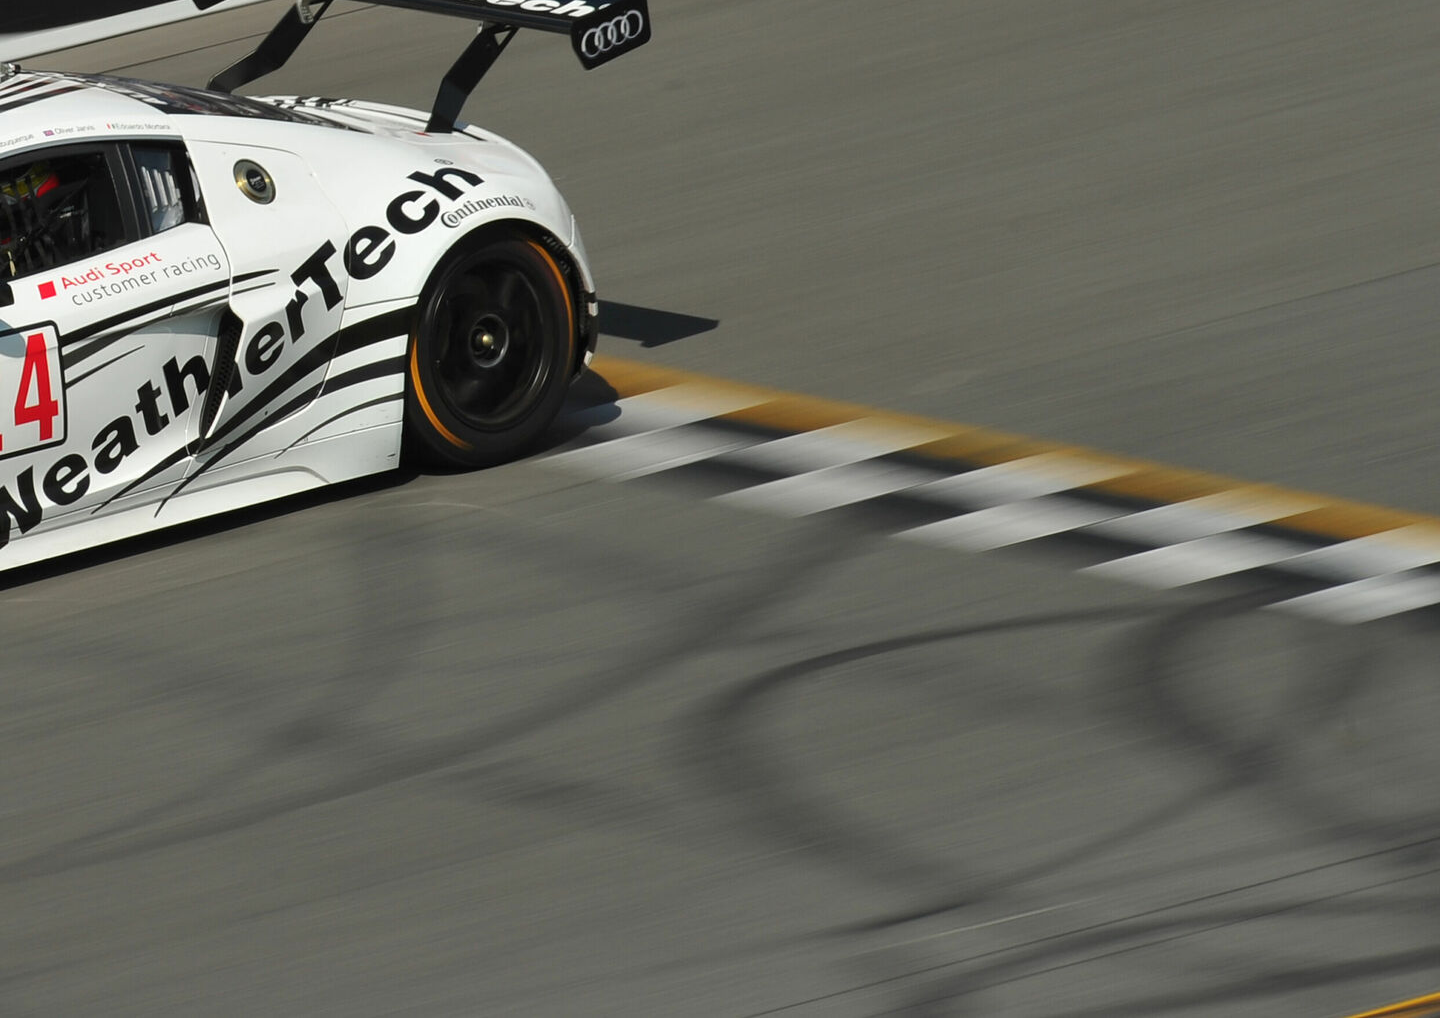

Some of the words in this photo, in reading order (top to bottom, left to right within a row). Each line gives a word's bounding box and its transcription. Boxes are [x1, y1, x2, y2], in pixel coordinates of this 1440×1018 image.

[441, 193, 525, 228] Continental
[61, 267, 102, 290] Audi
[105, 251, 162, 276] Sport
[71, 270, 159, 306] customer
[162, 252, 221, 279] racing
